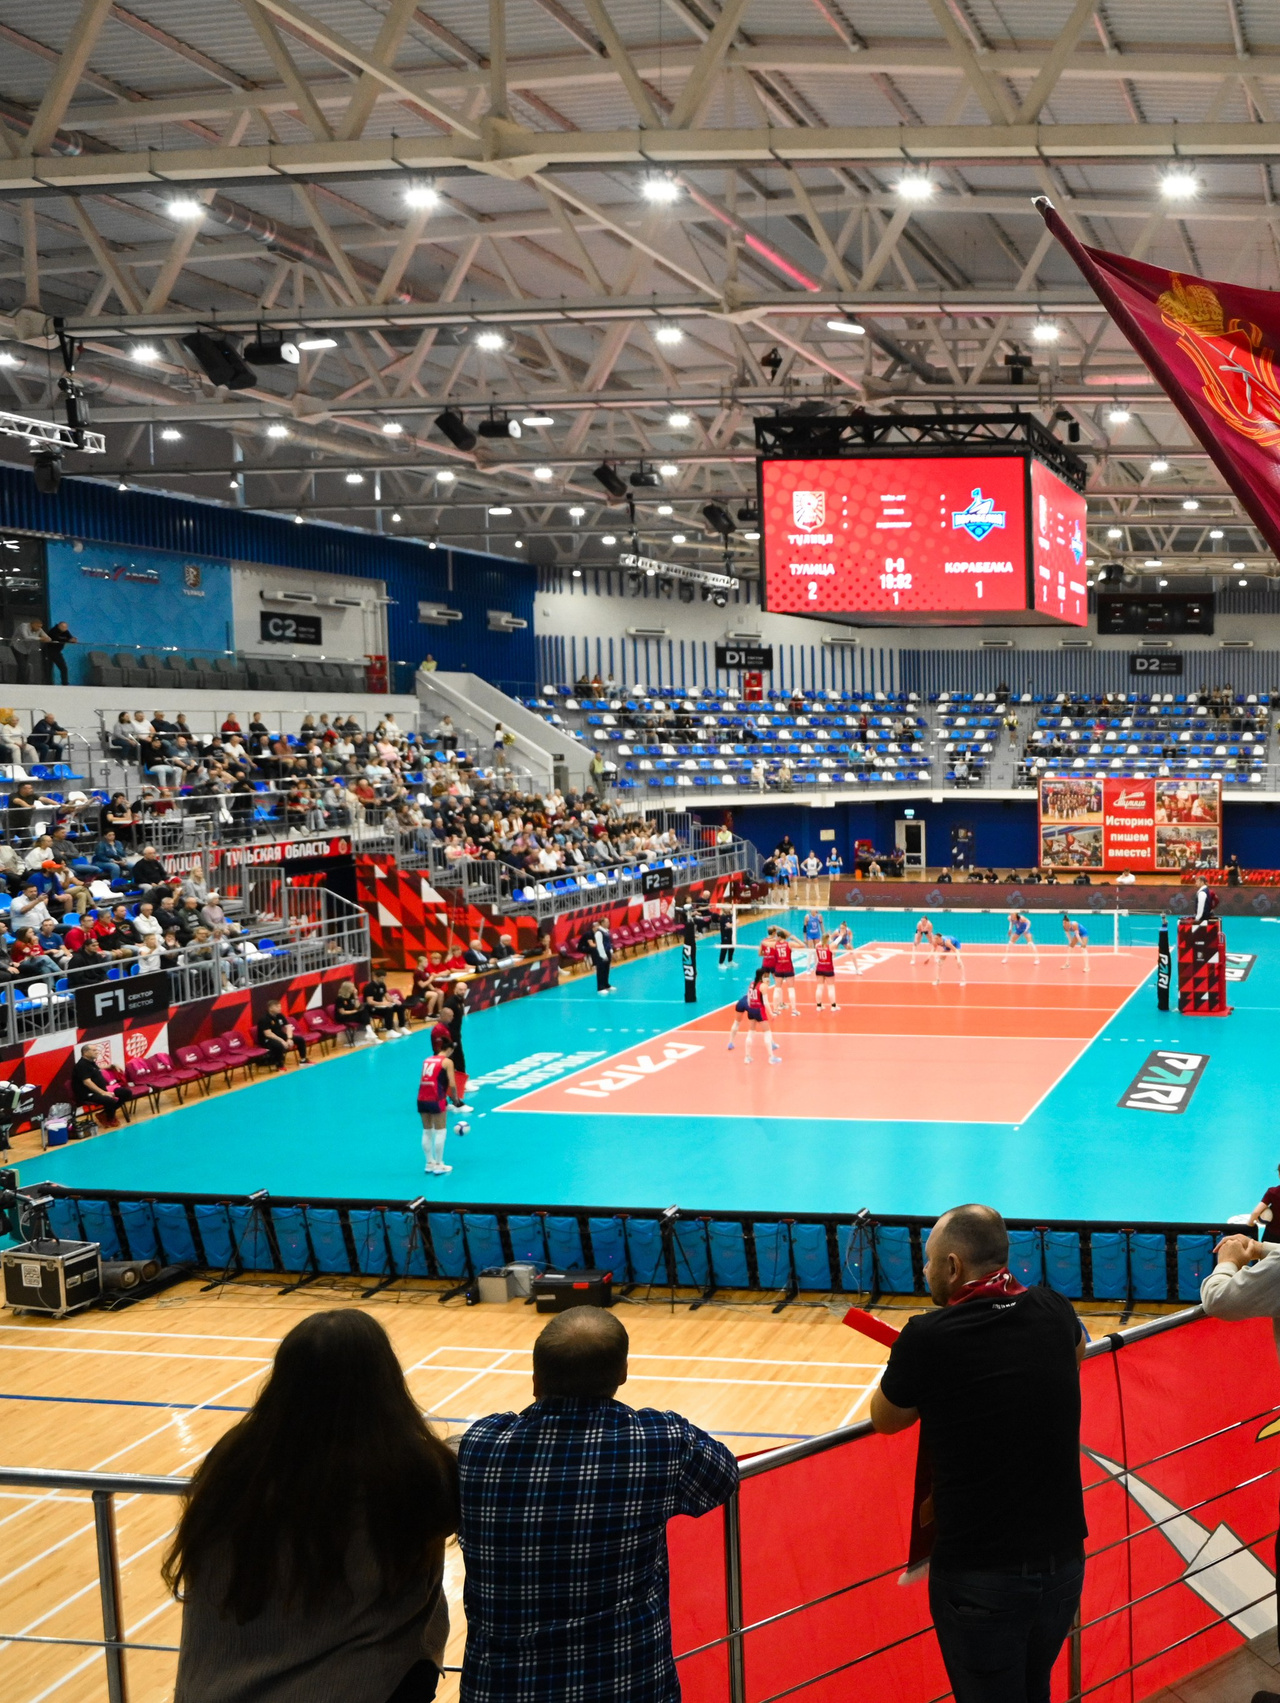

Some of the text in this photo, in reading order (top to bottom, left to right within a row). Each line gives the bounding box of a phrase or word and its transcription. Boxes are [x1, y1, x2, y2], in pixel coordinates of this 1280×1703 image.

[789, 563, 836, 577] ТУЛИЦА
[944, 561, 1014, 574] КОРАБЕЛКА
[807, 581, 818, 600] 2
[975, 580, 983, 598] 1
[893, 591, 899, 605] 1
[268, 617, 298, 638] C2
[726, 651, 746, 665] D1
[1135, 658, 1160, 671] D2
[1105, 814, 1154, 828] Историю
[1110, 833, 1149, 842] пишем
[284, 841, 331, 859] ОБЛАСТЬ
[1108, 847, 1151, 858] вместе!
[646, 873, 660, 890] F2
[777, 947, 787, 957] 15
[818, 950, 827, 960] 10
[1158, 953, 1169, 990] PARI
[94, 988, 126, 1017] F1
[128, 990, 154, 1001] СЕКТОР
[128, 998, 154, 1009] SECTOR
[422, 1062, 436, 1077] 14
[564, 1042, 705, 1097] PARI
[1125, 1051, 1203, 1111] PARI
